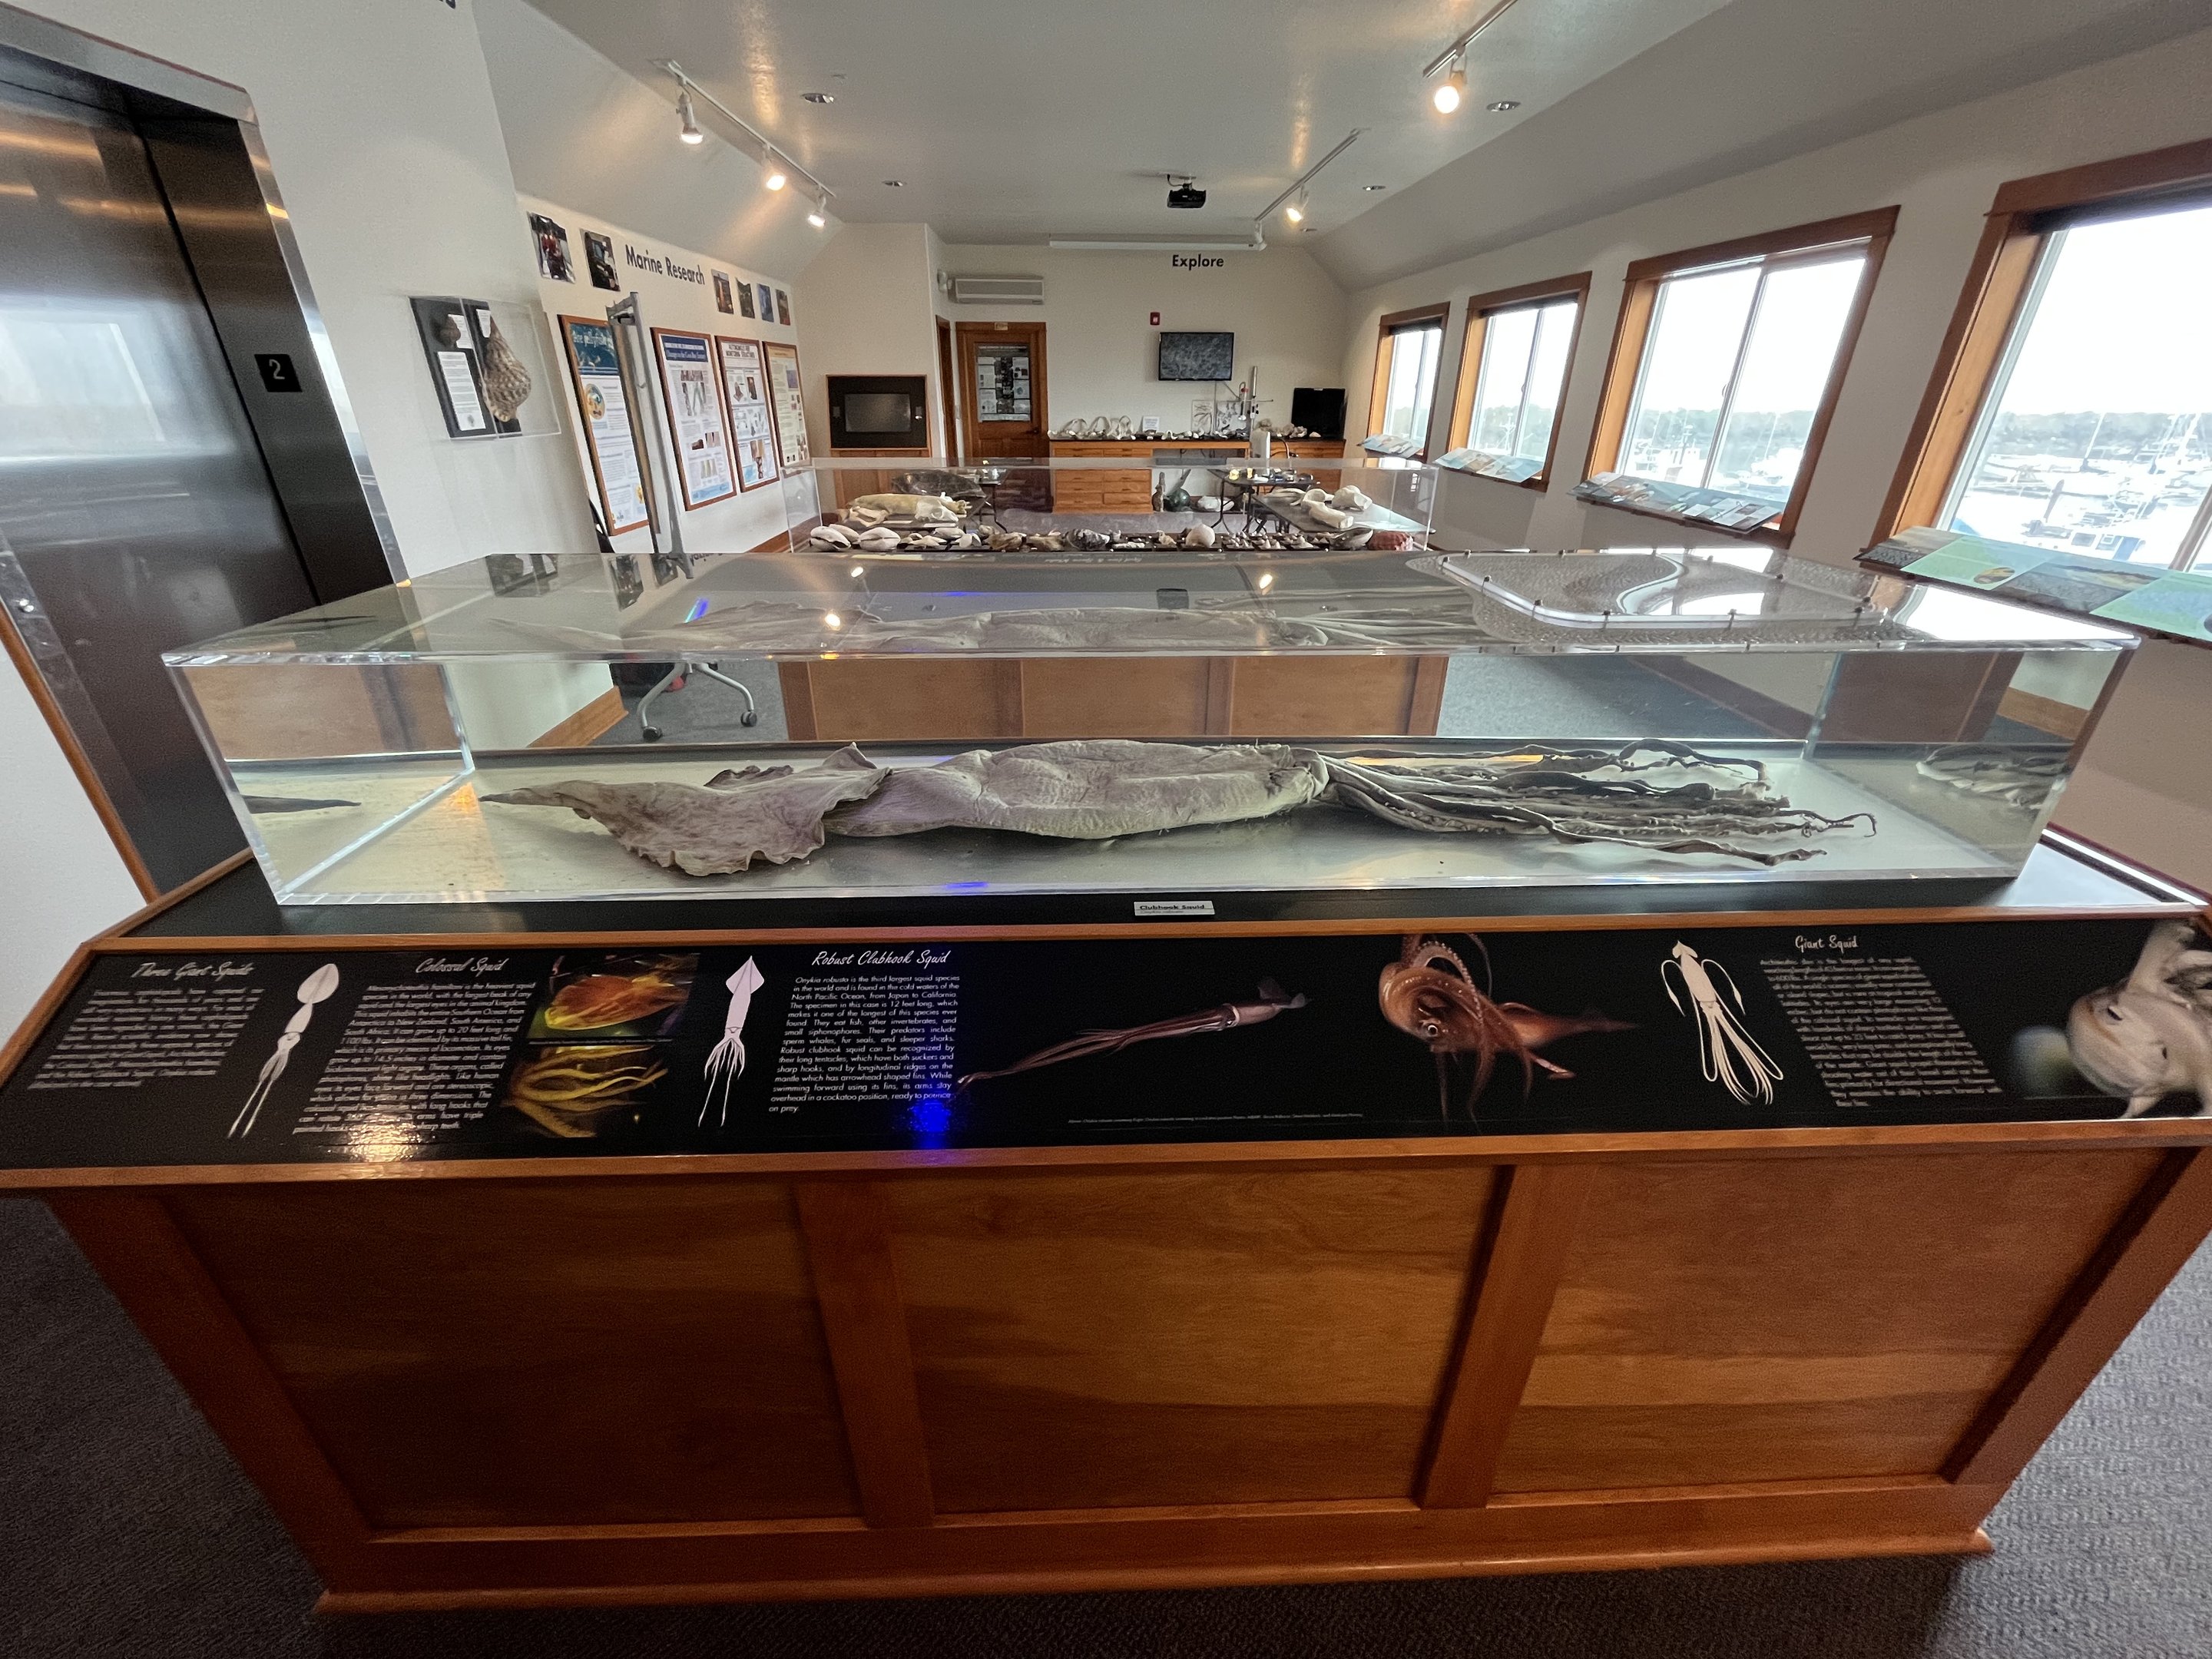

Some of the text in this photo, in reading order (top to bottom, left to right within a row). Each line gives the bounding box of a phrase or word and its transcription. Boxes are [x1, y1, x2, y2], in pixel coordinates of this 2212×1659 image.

[625, 244, 705, 285] Marine Research
[1172, 253, 1224, 270] Explore
[269, 359, 285, 379] 2
[1795, 935, 1858, 954] Giant Squid
[812, 949, 952, 969] Robust Clubhook Squid
[416, 957, 509, 977] Colossal Squid
[795, 976, 821, 985] Onykia
[889, 975, 912, 984] largest
[914, 975, 933, 983] squid
[935, 974, 960, 983] species
[813, 983, 834, 992] world
[857, 982, 878, 991] found
[899, 982, 915, 990] cold
[916, 982, 939, 990] waters
[791, 992, 813, 1001] North
[888, 992, 909, 1001] Japan
[911, 991, 919, 999] to
[805, 1001, 837, 1011] specimen
[849, 1000, 861, 1008] this
[890, 999, 899, 1008] 12
[937, 998, 958, 1007] which
[813, 1009, 818, 1018] it
[860, 1008, 886, 1018] longest
[913, 1008, 939, 1018] species
[813, 1018, 830, 1028] They
[833, 1018, 846, 1026] eat
[869, 1017, 886, 1025] other
[890, 1026, 925, 1036] predators
[930, 1025, 955, 1034] include
[899, 1035, 925, 1045] sleeper
[808, 1045, 841, 1054] clubhook
[846, 1045, 866, 1055] squid
[900, 1044, 942, 1054] recognized
[945, 1044, 954, 1053] by
[778, 1055, 794, 1064] their
[796, 1055, 813, 1065] long
[850, 1054, 873, 1062] which
[893, 1053, 910, 1061] both
[912, 1052, 938, 1061] suckers
[777, 1065, 798, 1075] sharp
[845, 1064, 855, 1073] by
[857, 1063, 901, 1073] longitudinal
[775, 1074, 800, 1082] mantle
[826, 1073, 839, 1081] has
[840, 1072, 882, 1081] arrowhead
[883, 1072, 910, 1082] shaped
[813, 1083, 844, 1091] forward
[847, 1083, 868, 1093] using
[871, 1082, 879, 1091] its
[807, 1093, 815, 1101] in
[823, 1092, 857, 1101] cockatoo
[891, 1091, 913, 1101] ready
